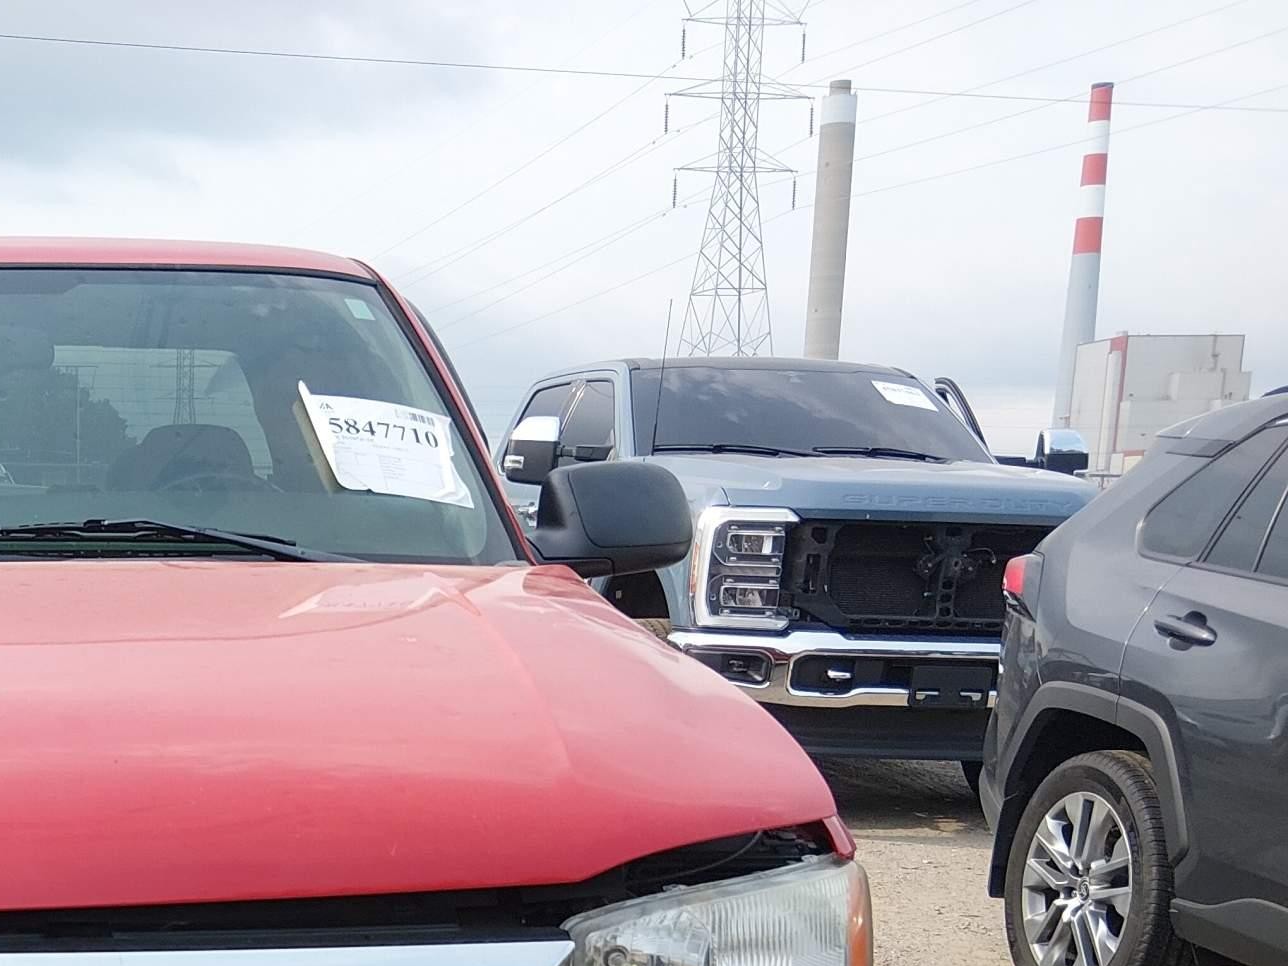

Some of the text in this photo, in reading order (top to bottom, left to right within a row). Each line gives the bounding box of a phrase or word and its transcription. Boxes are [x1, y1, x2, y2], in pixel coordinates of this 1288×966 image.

[328, 417, 439, 449] 5847710
[842, 494, 1073, 512] SUPER DUTY
